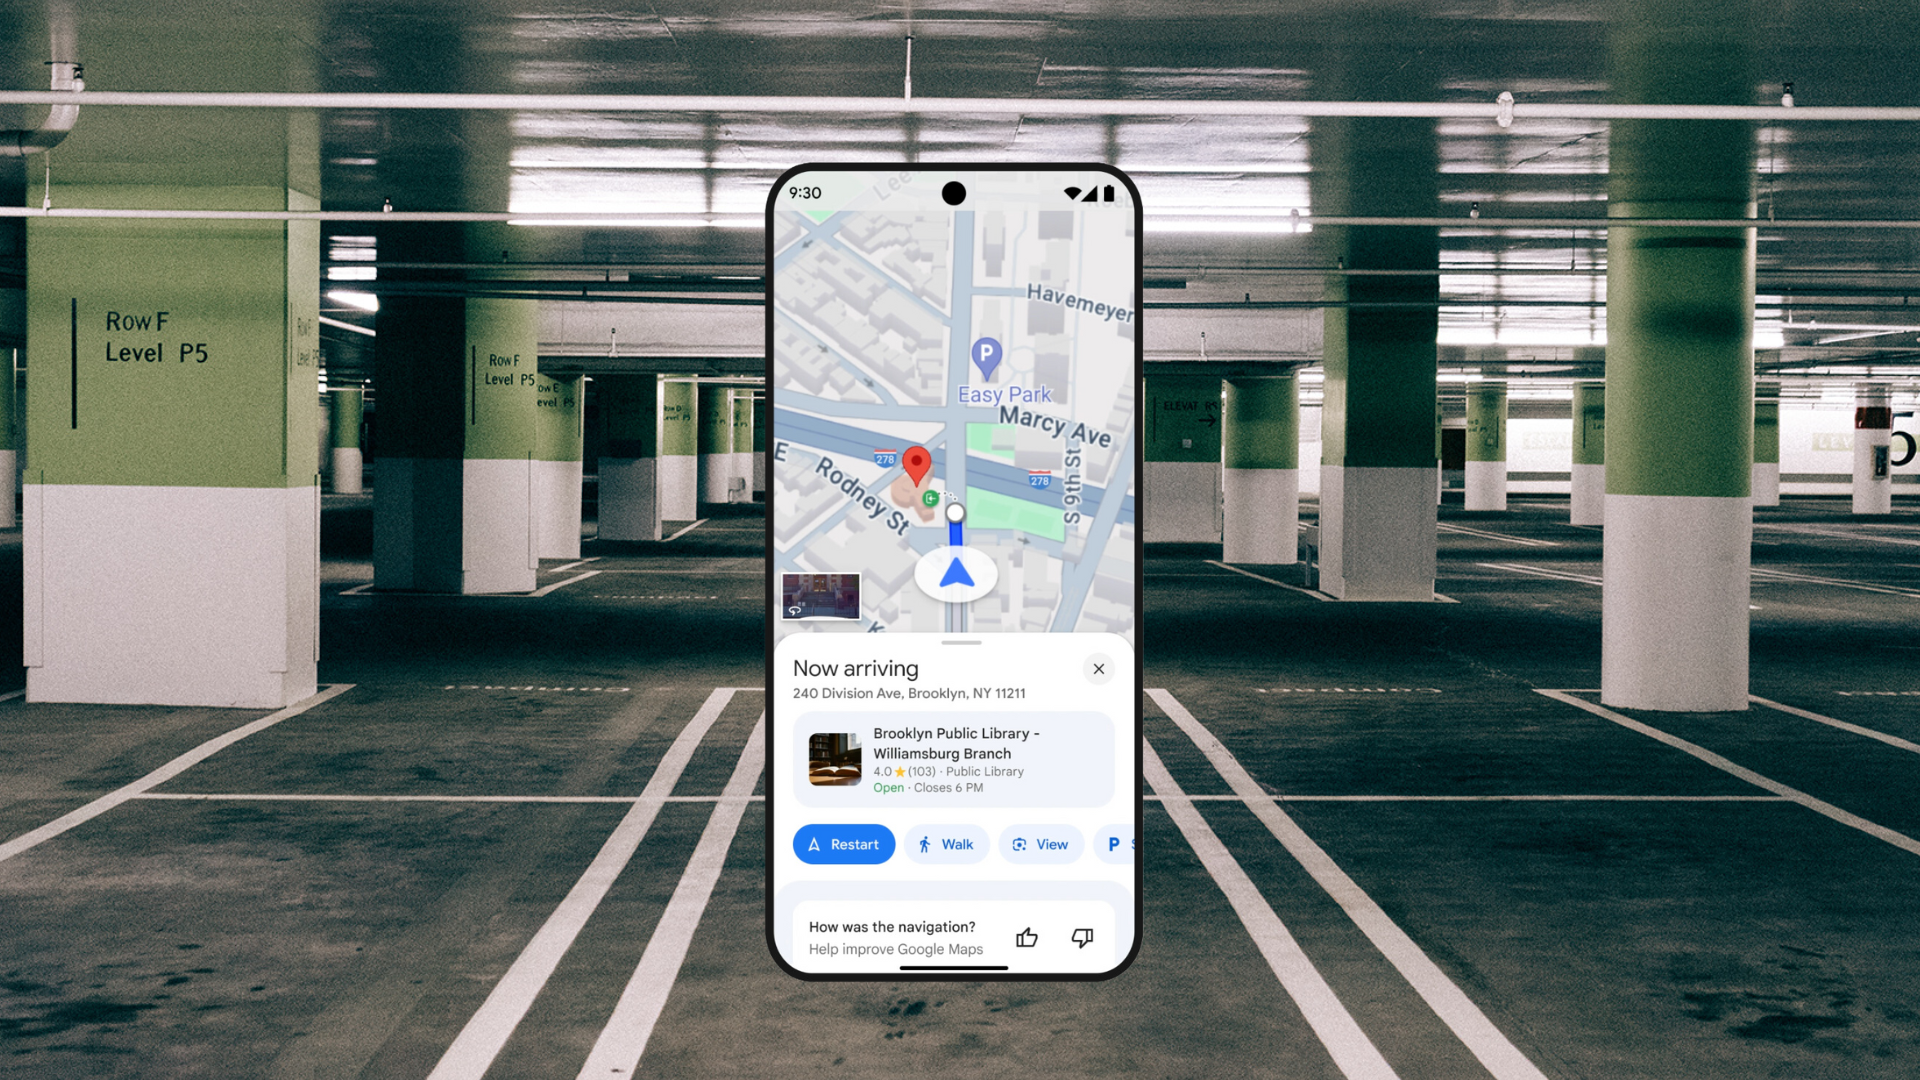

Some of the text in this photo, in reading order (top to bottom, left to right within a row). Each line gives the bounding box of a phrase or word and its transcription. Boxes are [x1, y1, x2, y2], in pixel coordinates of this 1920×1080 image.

[789, 186, 822, 200] 9:30
[1027, 283, 1134, 323] Havemeyer
[106, 311, 170, 332] Row F
[106, 342, 208, 363] Level P5
[981, 344, 994, 361] P
[489, 354, 520, 367] Row F
[485, 373, 535, 386] Level P5
[553, 383, 560, 393] E
[537, 398, 557, 407] evel
[959, 385, 1052, 407] Easy Park
[1164, 401, 1218, 411] ELEVATRS
[1000, 405, 1112, 448] Marcy Ave
[774, 442, 789, 462] E
[876, 455, 895, 465] 278
[1031, 476, 1050, 486] 278
[1064, 448, 1081, 525] S 9th St
[815, 456, 910, 536] Rodney St
[794, 659, 919, 681] Now arriving
[793, 687, 1026, 702] 240 Division Ave, Brooklyn, NY 11211
[874, 727, 933, 743] Brooklyn
[937, 727, 978, 740] Public
[982, 727, 1030, 743] Library
[873, 748, 1012, 763] Williamsburg Branch
[873, 766, 1024, 779] 4.0 (103) Public Library
[874, 783, 984, 795] Open Closes 6 PM
[831, 838, 879, 851] Restart
[942, 838, 974, 850] Walk
[1036, 838, 1069, 850] View
[1109, 837, 1120, 851] P
[809, 921, 976, 936] How was the navigation?
[809, 943, 984, 957] Help improve Google Maps
